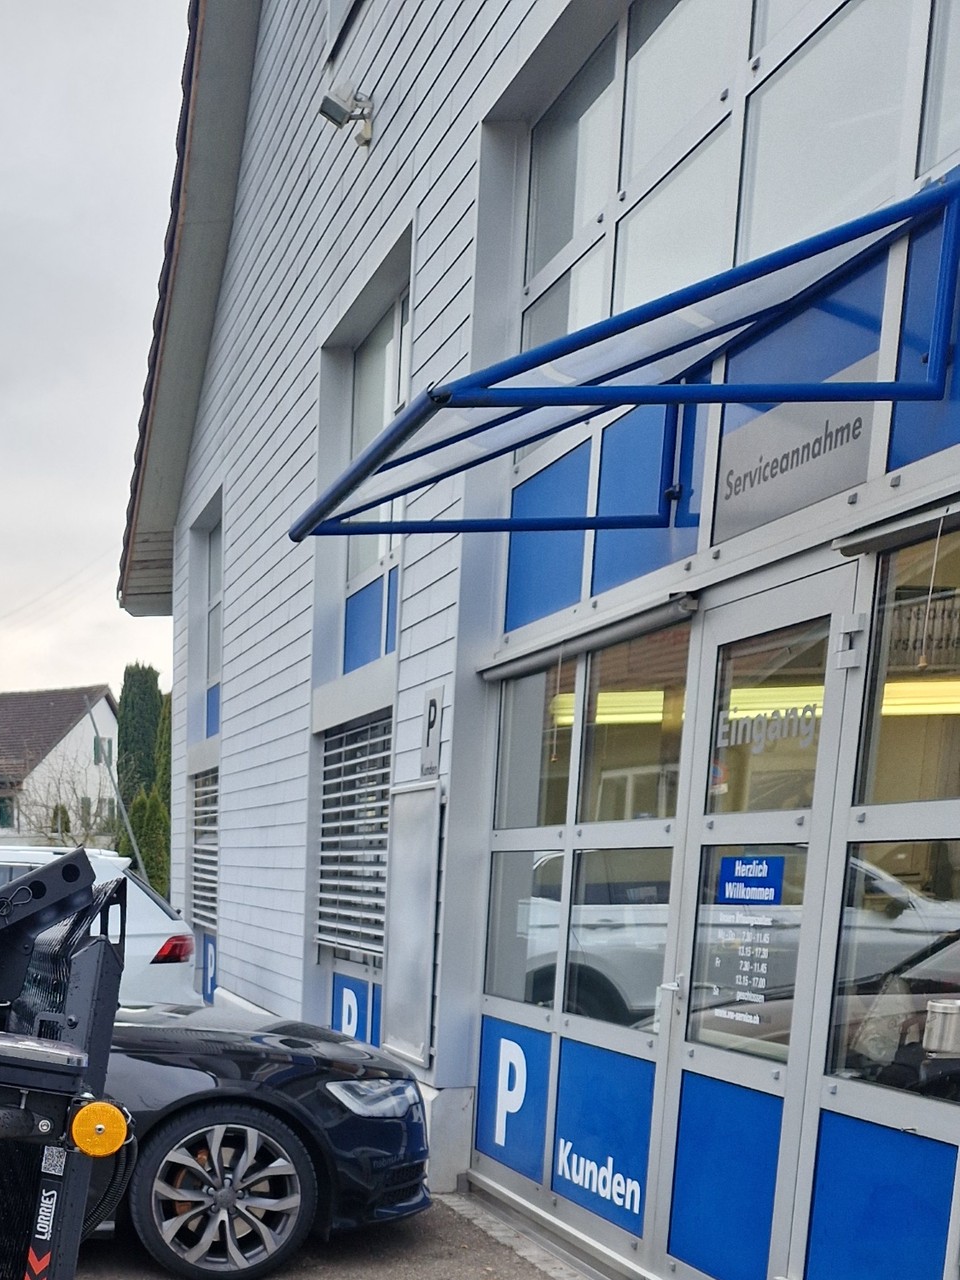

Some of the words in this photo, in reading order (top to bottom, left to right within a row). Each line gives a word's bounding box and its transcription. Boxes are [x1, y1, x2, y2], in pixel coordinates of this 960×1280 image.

[725, 417, 863, 500] Serviceannahme
[426, 698, 437, 747] P
[717, 703, 817, 755] Eingang
[725, 881, 775, 900] Willkommen
[734, 860, 768, 877] Herzlich
[494, 1038, 528, 1146] P
[558, 1138, 641, 1215] Kunden
[35, 1188, 57, 1241] LORRIES
